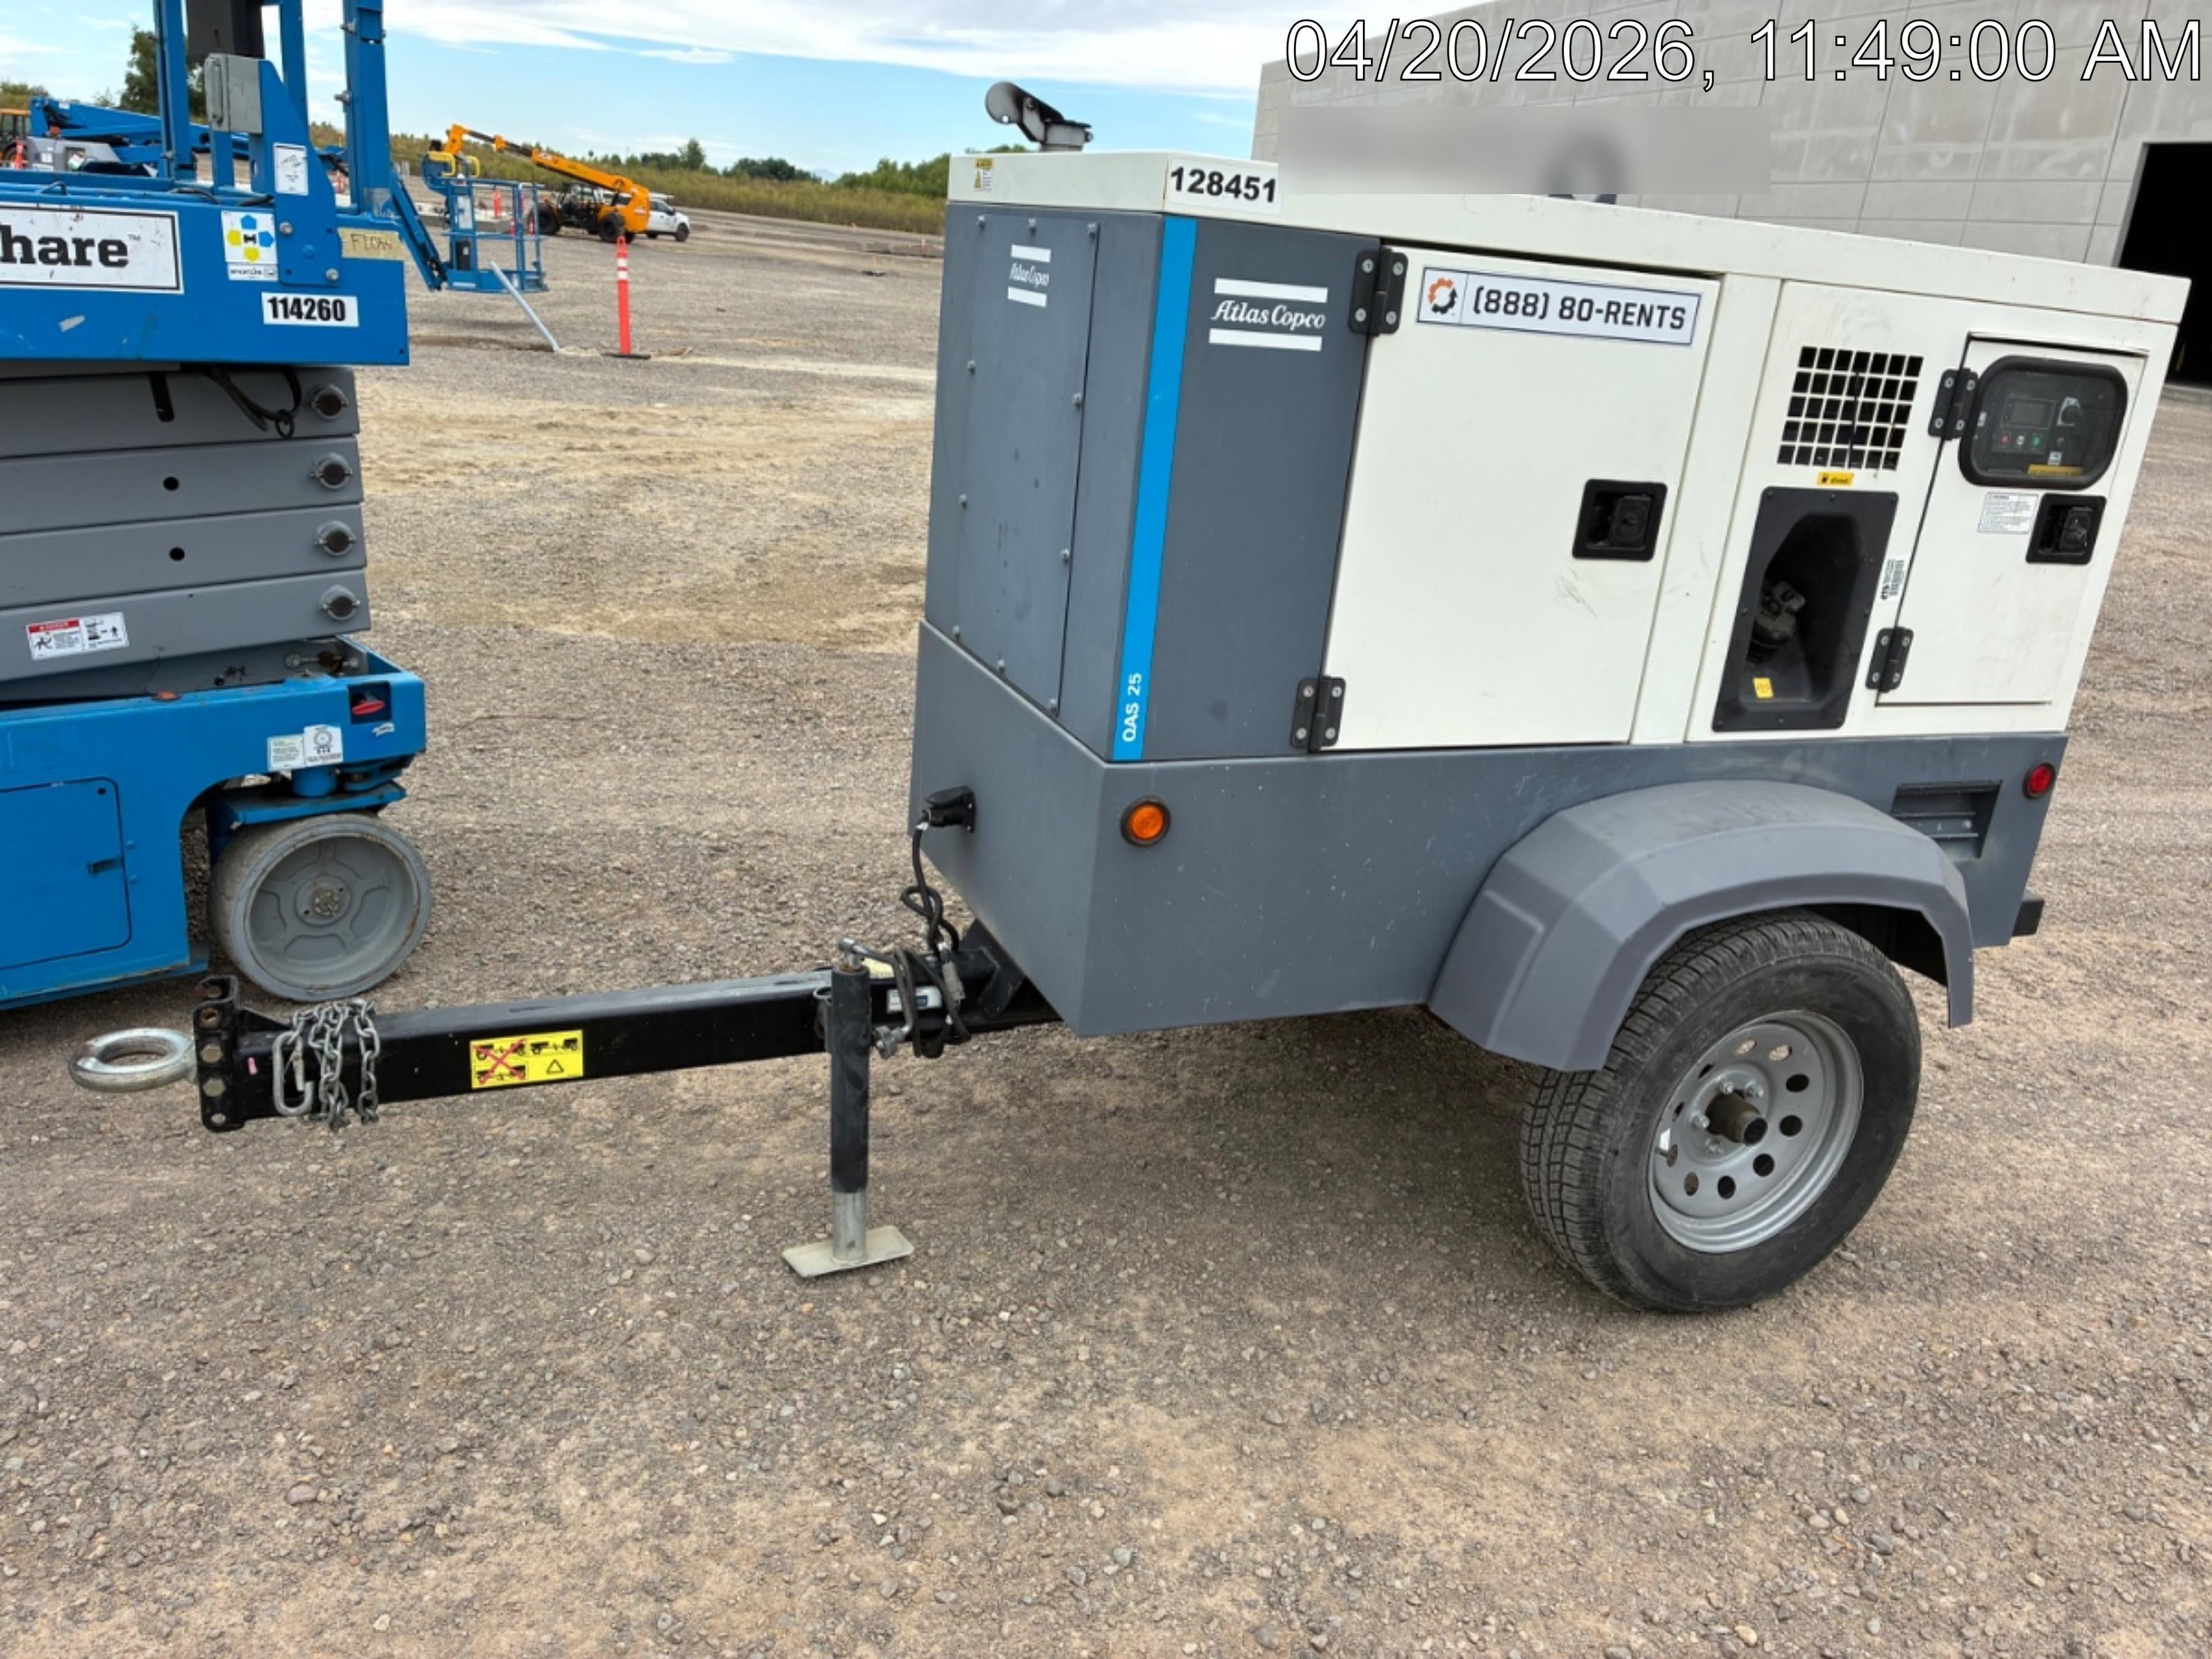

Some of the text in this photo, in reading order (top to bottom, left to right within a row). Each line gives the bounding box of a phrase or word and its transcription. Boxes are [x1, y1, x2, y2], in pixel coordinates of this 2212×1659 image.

[1171, 166, 1276, 203] 128451
[267, 297, 345, 321] 114260
[1210, 299, 1326, 331] Atlas Copco
[1473, 286, 1686, 330] (888) 80-RENTS
[1128, 672, 1142, 696] 25
